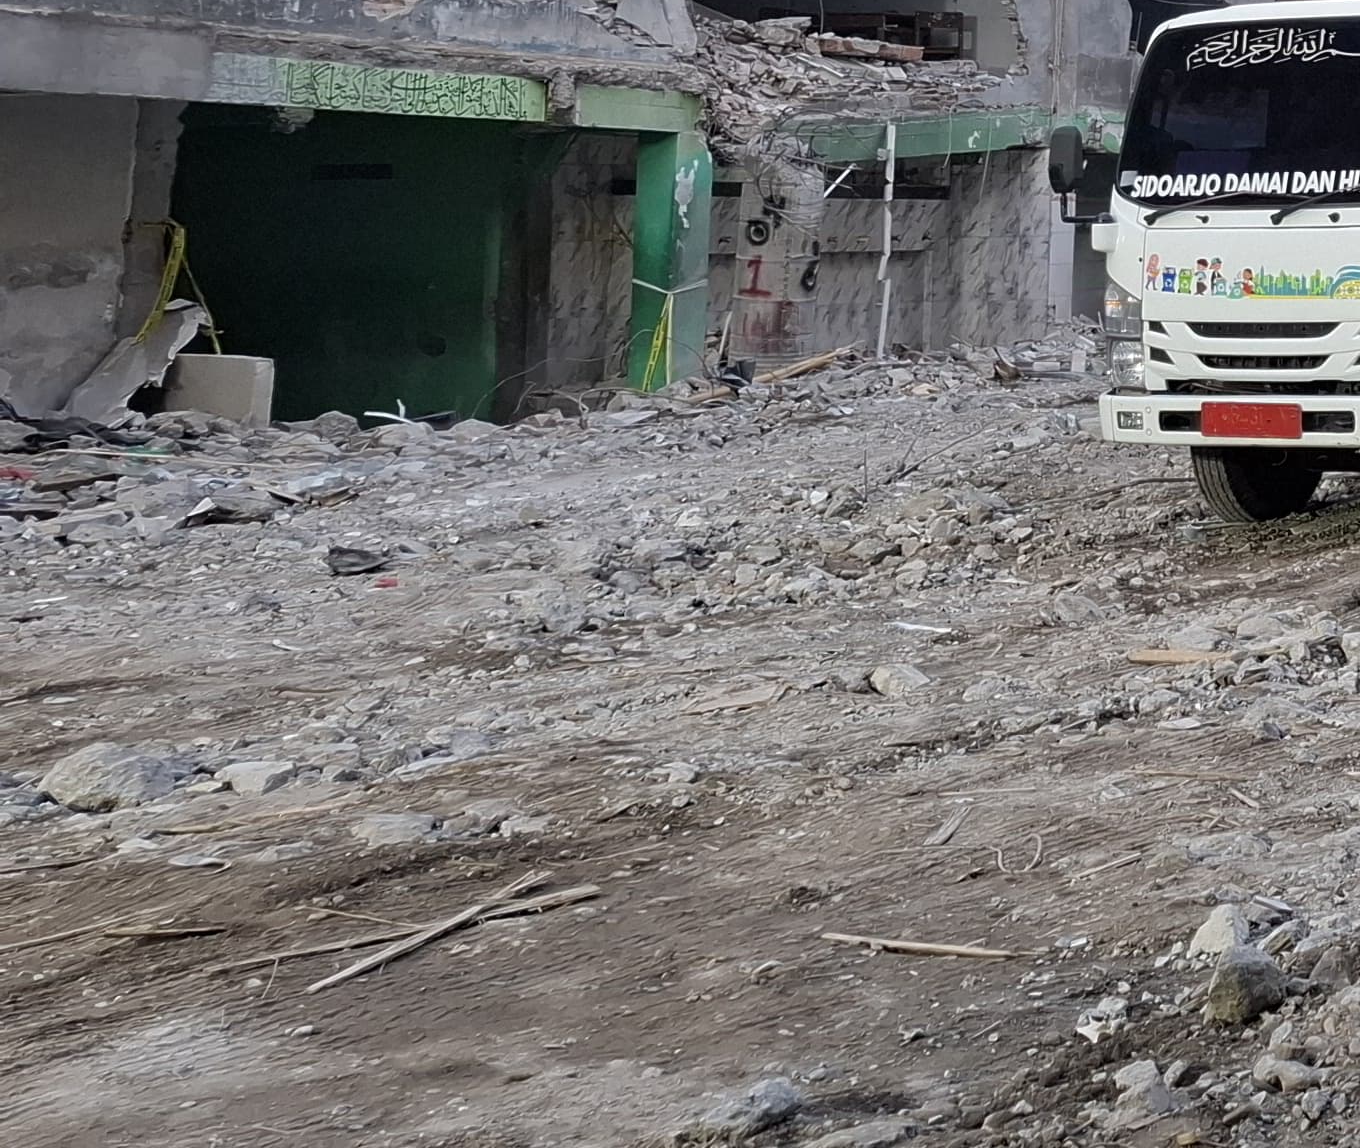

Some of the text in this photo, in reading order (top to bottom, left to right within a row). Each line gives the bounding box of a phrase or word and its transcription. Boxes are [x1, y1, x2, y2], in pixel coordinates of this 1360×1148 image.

[1131, 174, 1221, 198] SIDOARJO
[1224, 171, 1288, 193] DAMAI
[1291, 171, 1336, 194] DAN
